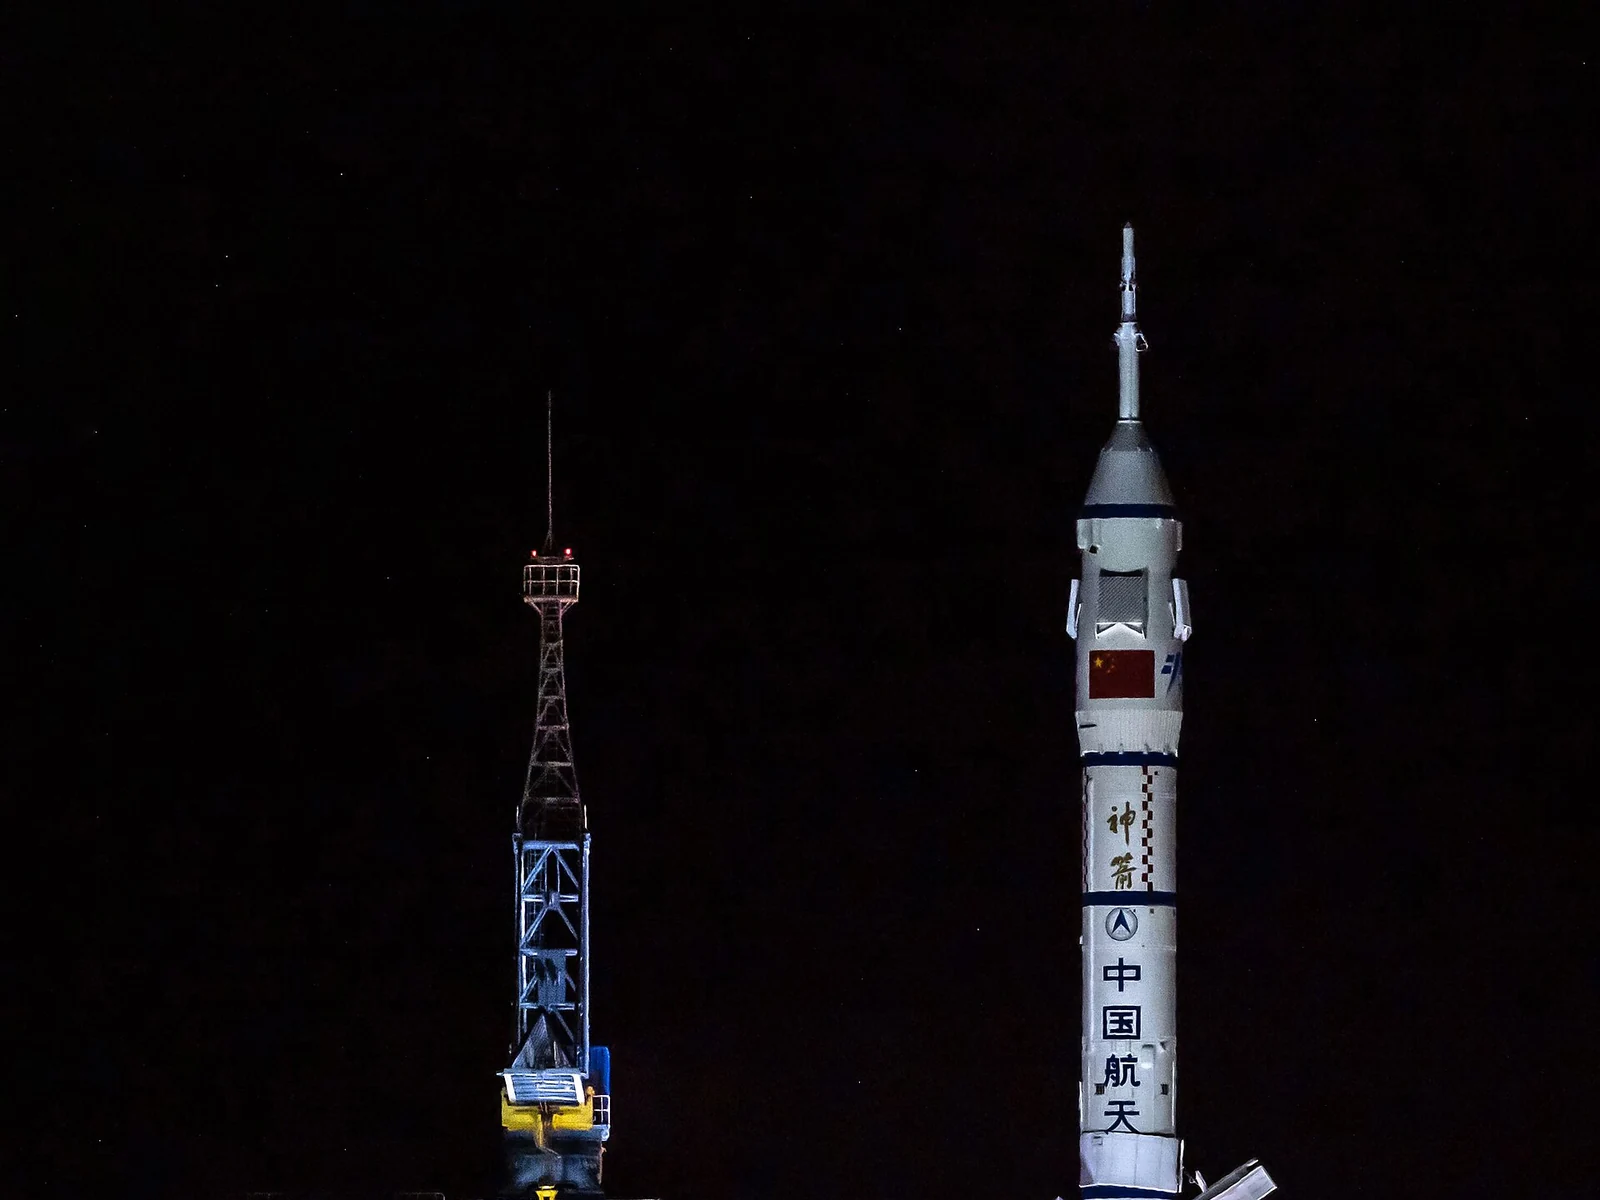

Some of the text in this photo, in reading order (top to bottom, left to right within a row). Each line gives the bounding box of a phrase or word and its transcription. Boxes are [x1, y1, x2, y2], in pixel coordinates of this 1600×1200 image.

[1106, 801, 1137, 890] 神箭
[1102, 957, 1142, 1133] 中国航天
